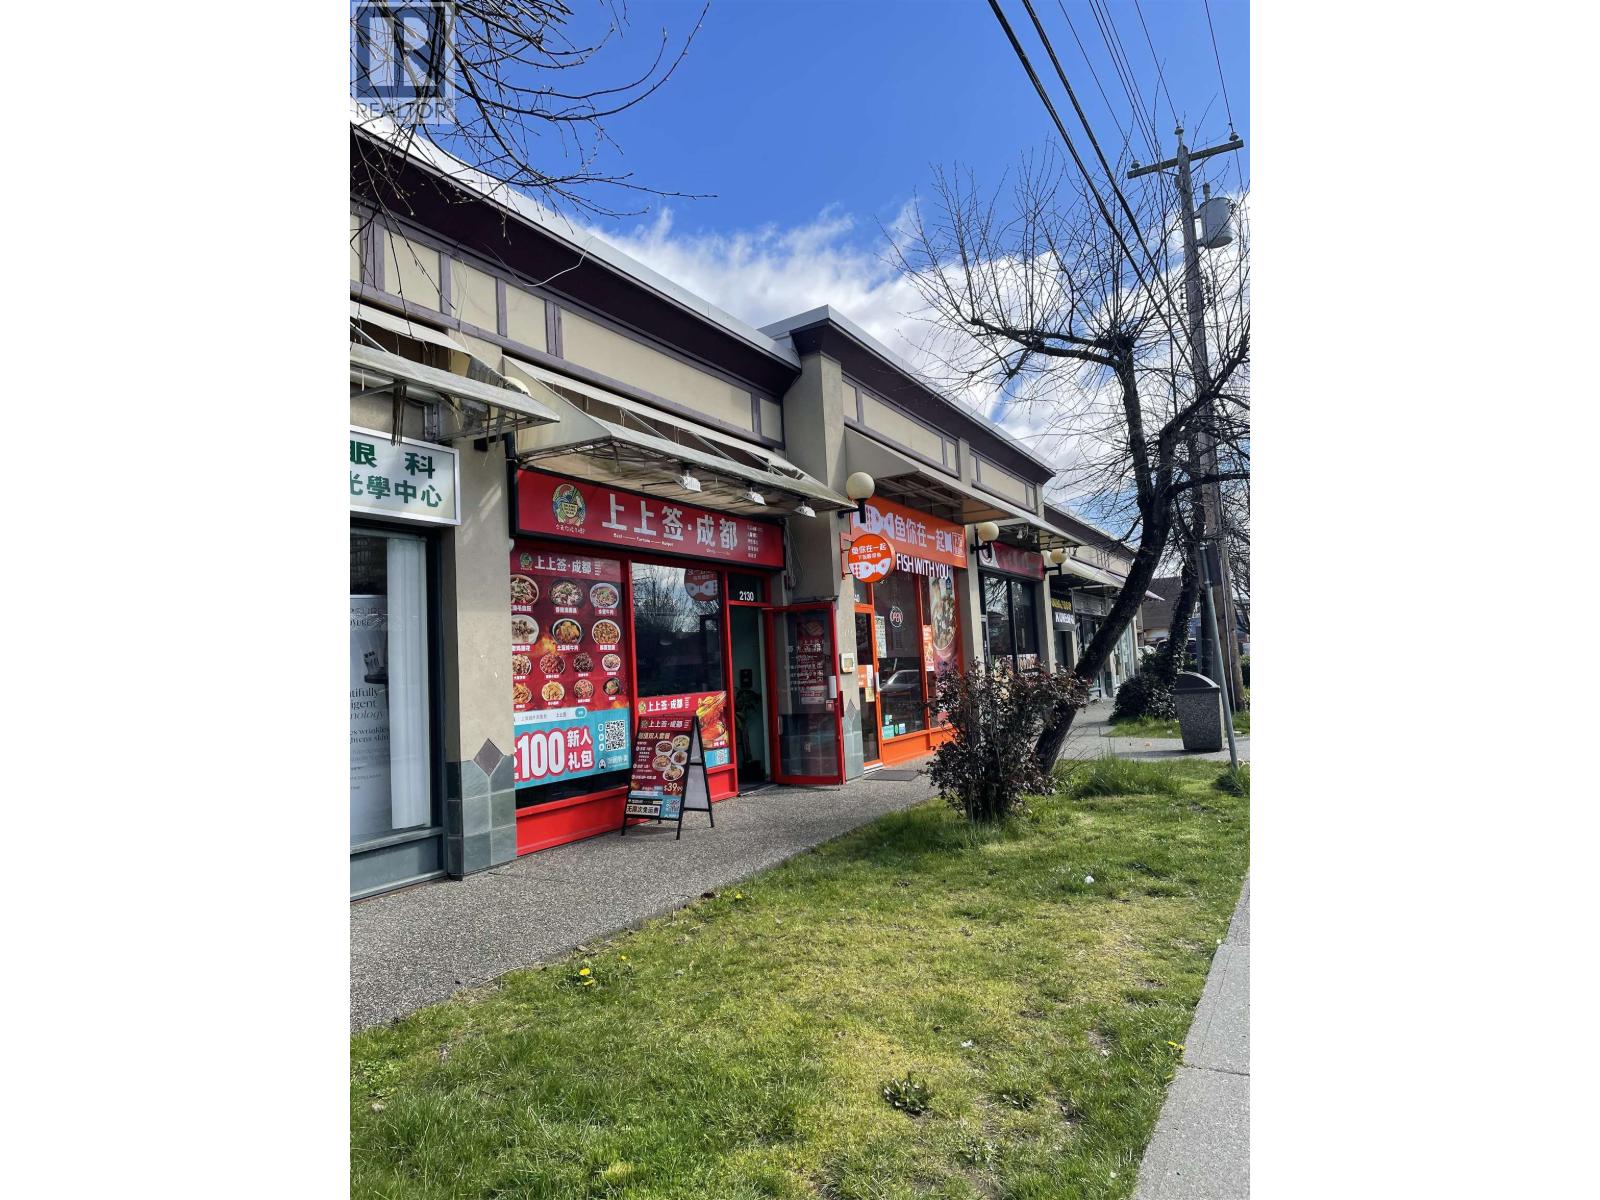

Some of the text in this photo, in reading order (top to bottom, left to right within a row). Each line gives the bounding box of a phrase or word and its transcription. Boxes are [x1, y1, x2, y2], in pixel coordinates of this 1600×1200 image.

[895, 514, 945, 553] 鱼你在一起
[896, 553, 949, 580] FISH WITH YOU
[739, 590, 755, 602] 2130
[567, 728, 592, 748] 新人
[568, 750, 593, 770] 礼包
